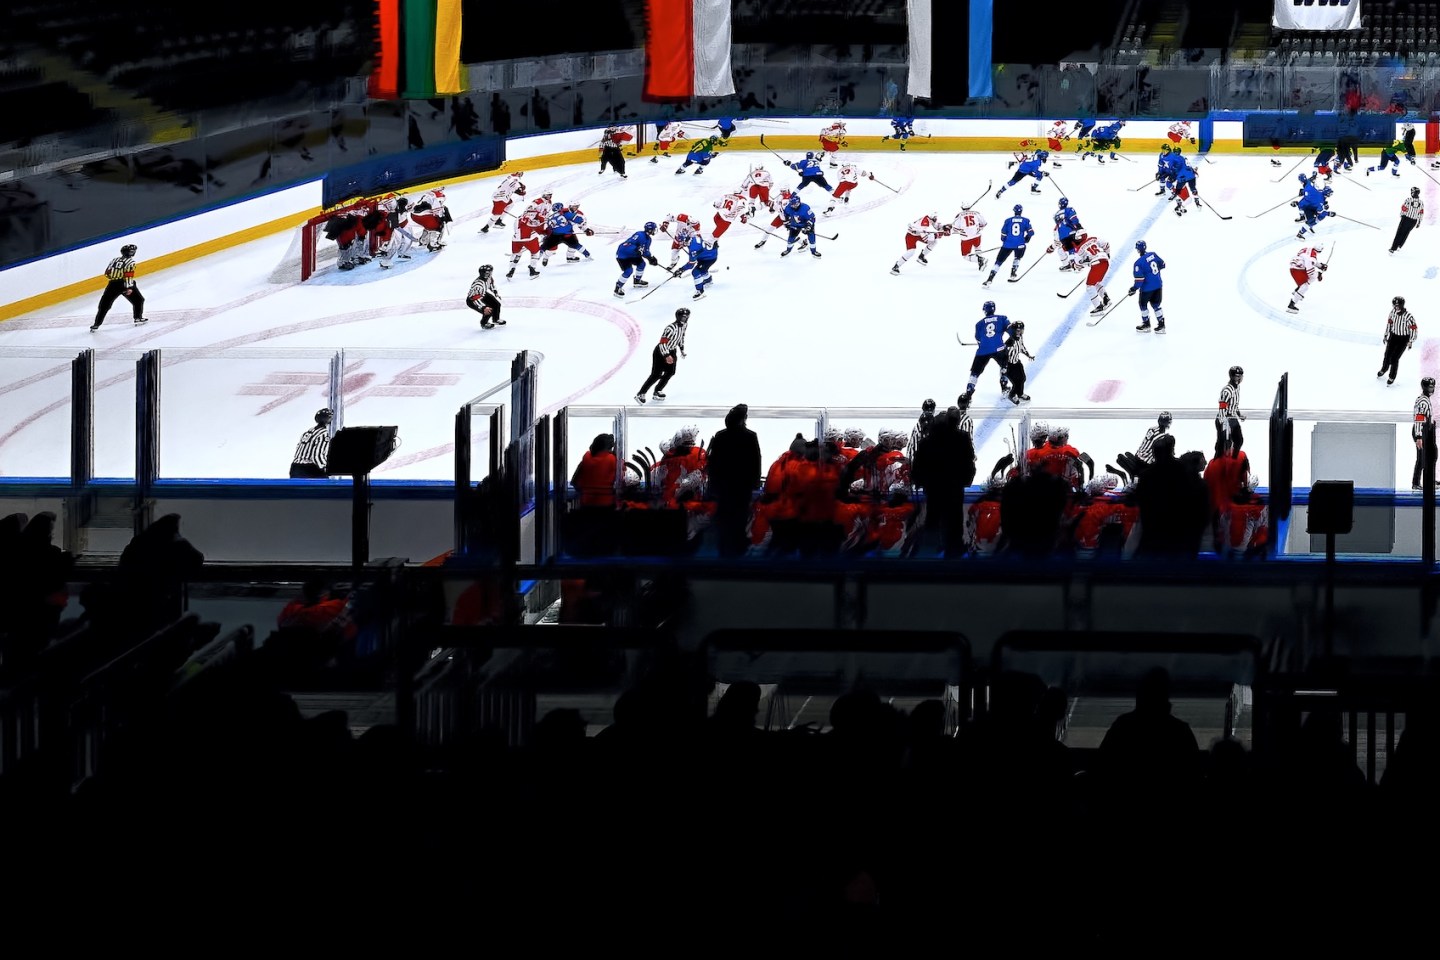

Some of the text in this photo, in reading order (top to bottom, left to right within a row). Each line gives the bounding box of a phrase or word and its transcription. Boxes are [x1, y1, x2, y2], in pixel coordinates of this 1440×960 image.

[964, 215, 975, 227] 15
[1012, 223, 1021, 236] 8
[1150, 261, 1159, 275] 8
[985, 323, 996, 338] 8
